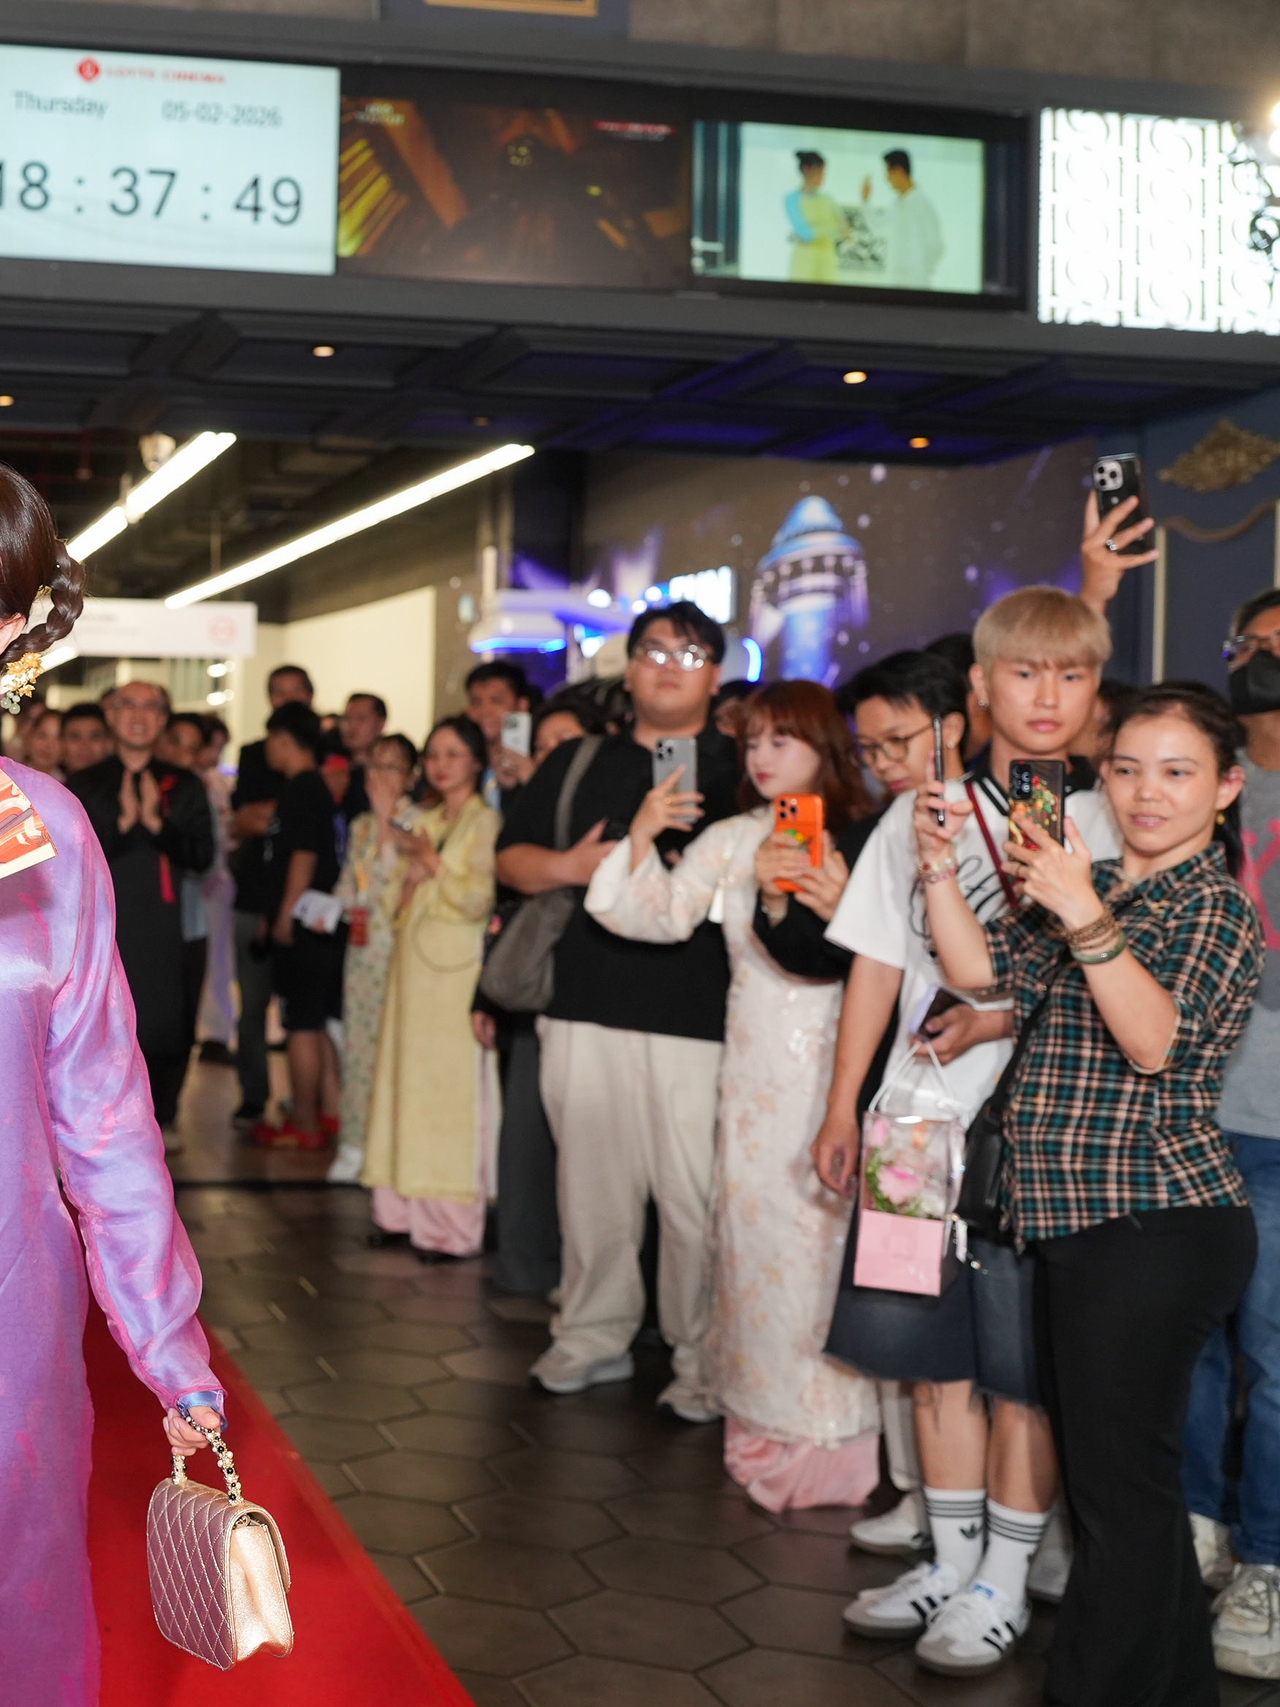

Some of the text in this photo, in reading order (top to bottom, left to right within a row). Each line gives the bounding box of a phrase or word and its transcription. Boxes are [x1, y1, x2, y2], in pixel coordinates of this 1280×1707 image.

[13, 89, 108, 121] Thursday
[160, 99, 284, 129] 05-02-2026
[108, 166, 180, 219] 37
[232, 174, 304, 227] 49
